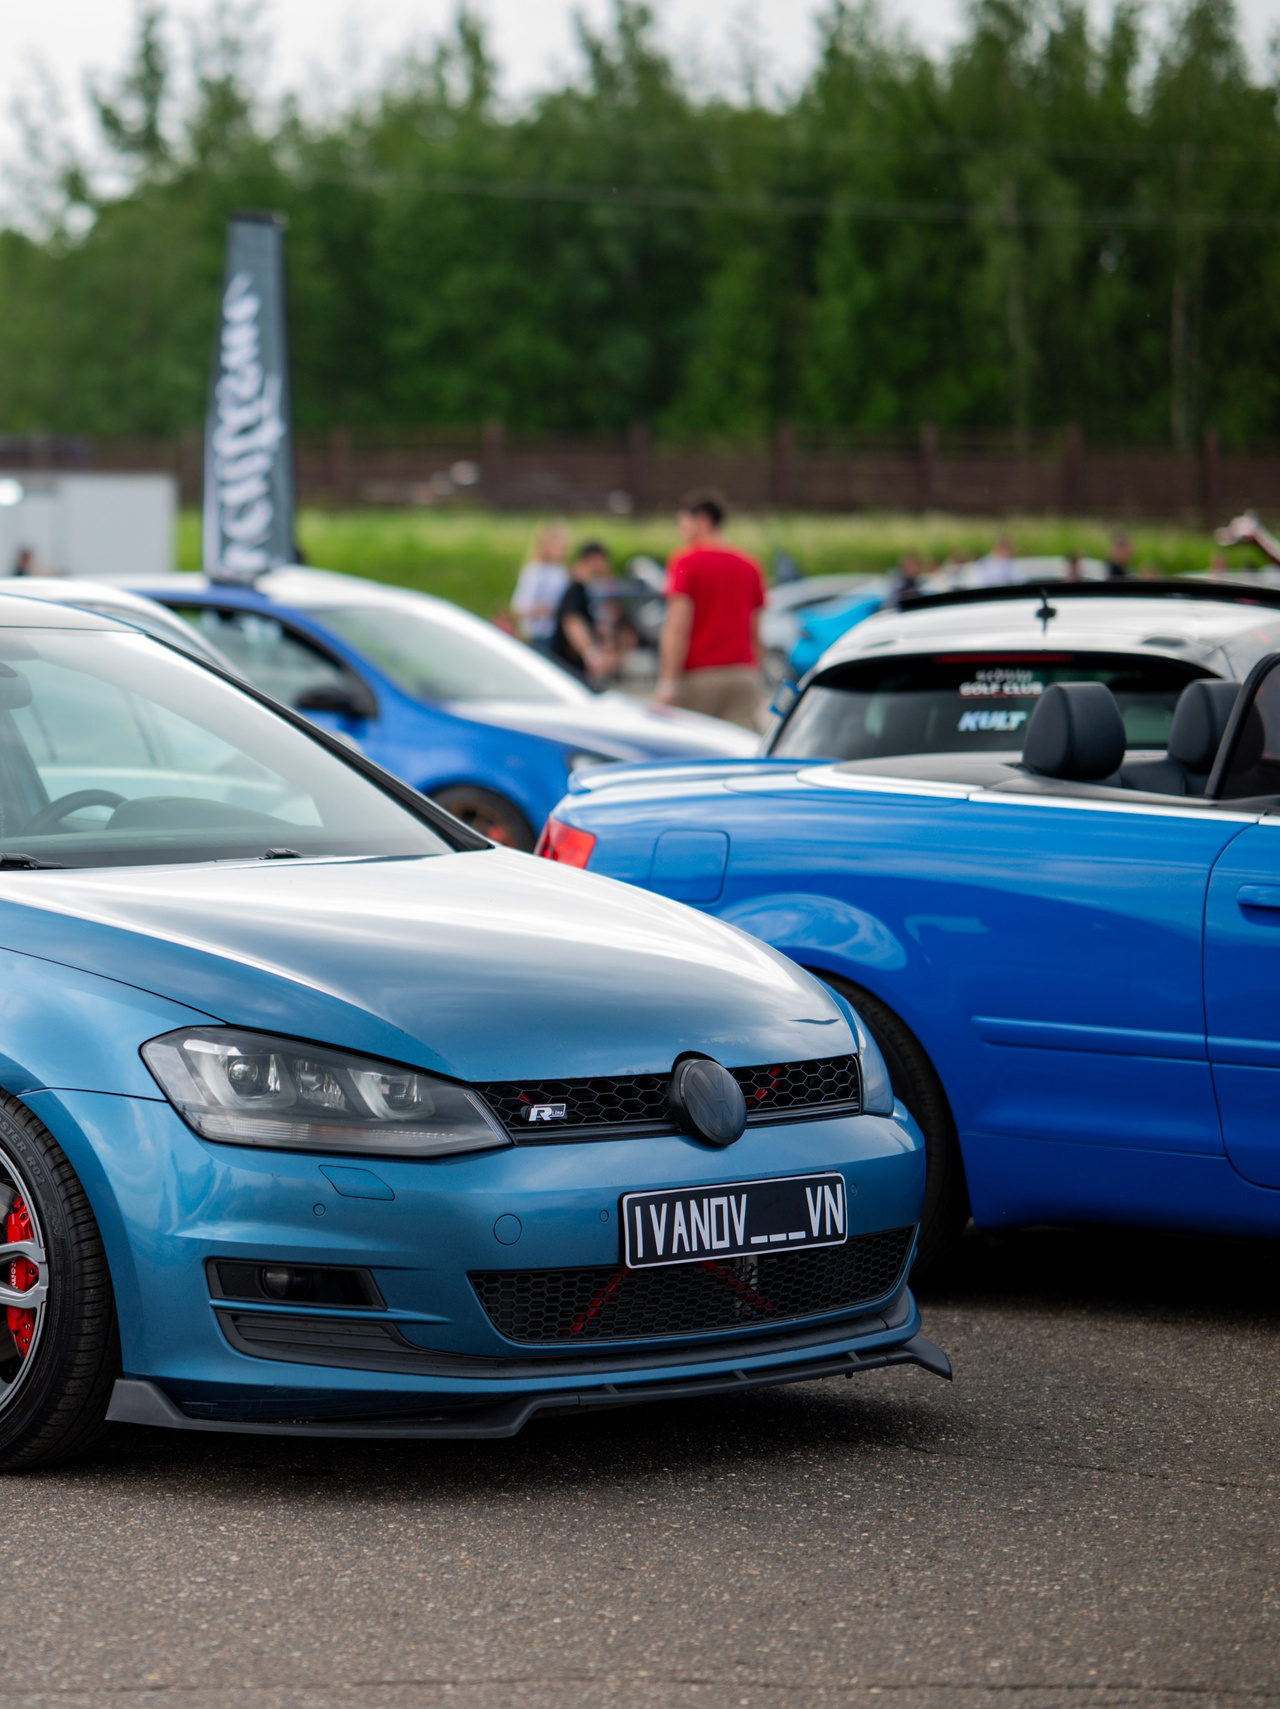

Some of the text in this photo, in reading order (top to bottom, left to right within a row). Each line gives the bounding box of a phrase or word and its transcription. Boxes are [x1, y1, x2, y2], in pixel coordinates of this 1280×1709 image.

[959, 681, 1043, 696] GOLF CLUB
[957, 710, 1028, 732] KULT
[529, 1107, 552, 1121] R
[26, 1155, 46, 1184] R02
